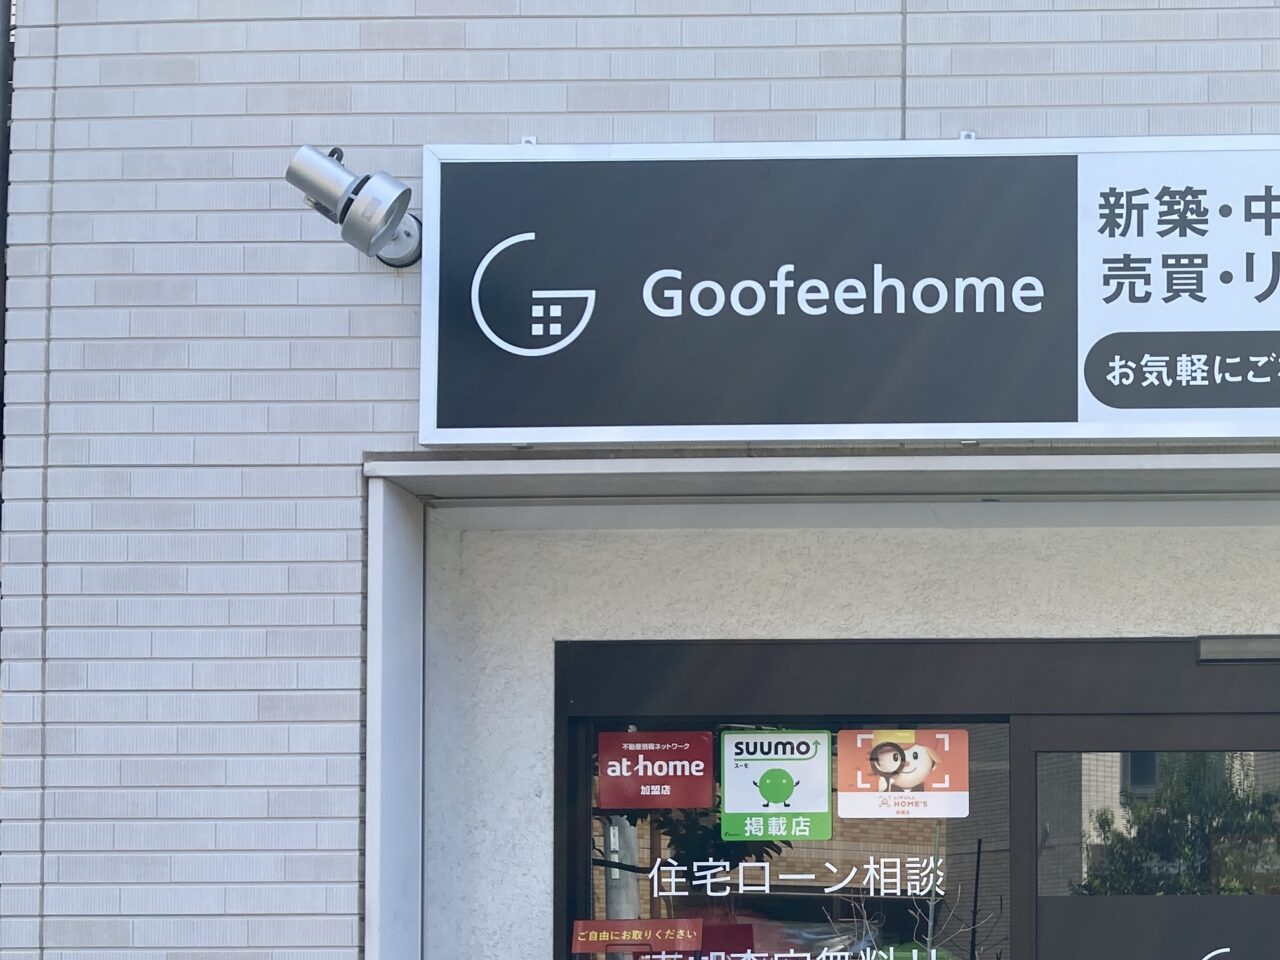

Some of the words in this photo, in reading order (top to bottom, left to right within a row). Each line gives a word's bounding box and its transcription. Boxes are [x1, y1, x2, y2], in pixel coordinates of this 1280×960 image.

[642, 263, 1045, 318] Goofeehome
[606, 757, 632, 777] at
[633, 754, 705, 777] home
[640, 784, 671, 796] 加盟店
[744, 816, 811, 837] 掲載店
[648, 857, 946, 898] 住宅ローン相談
[577, 929, 697, 942] ご自由にお取りください
